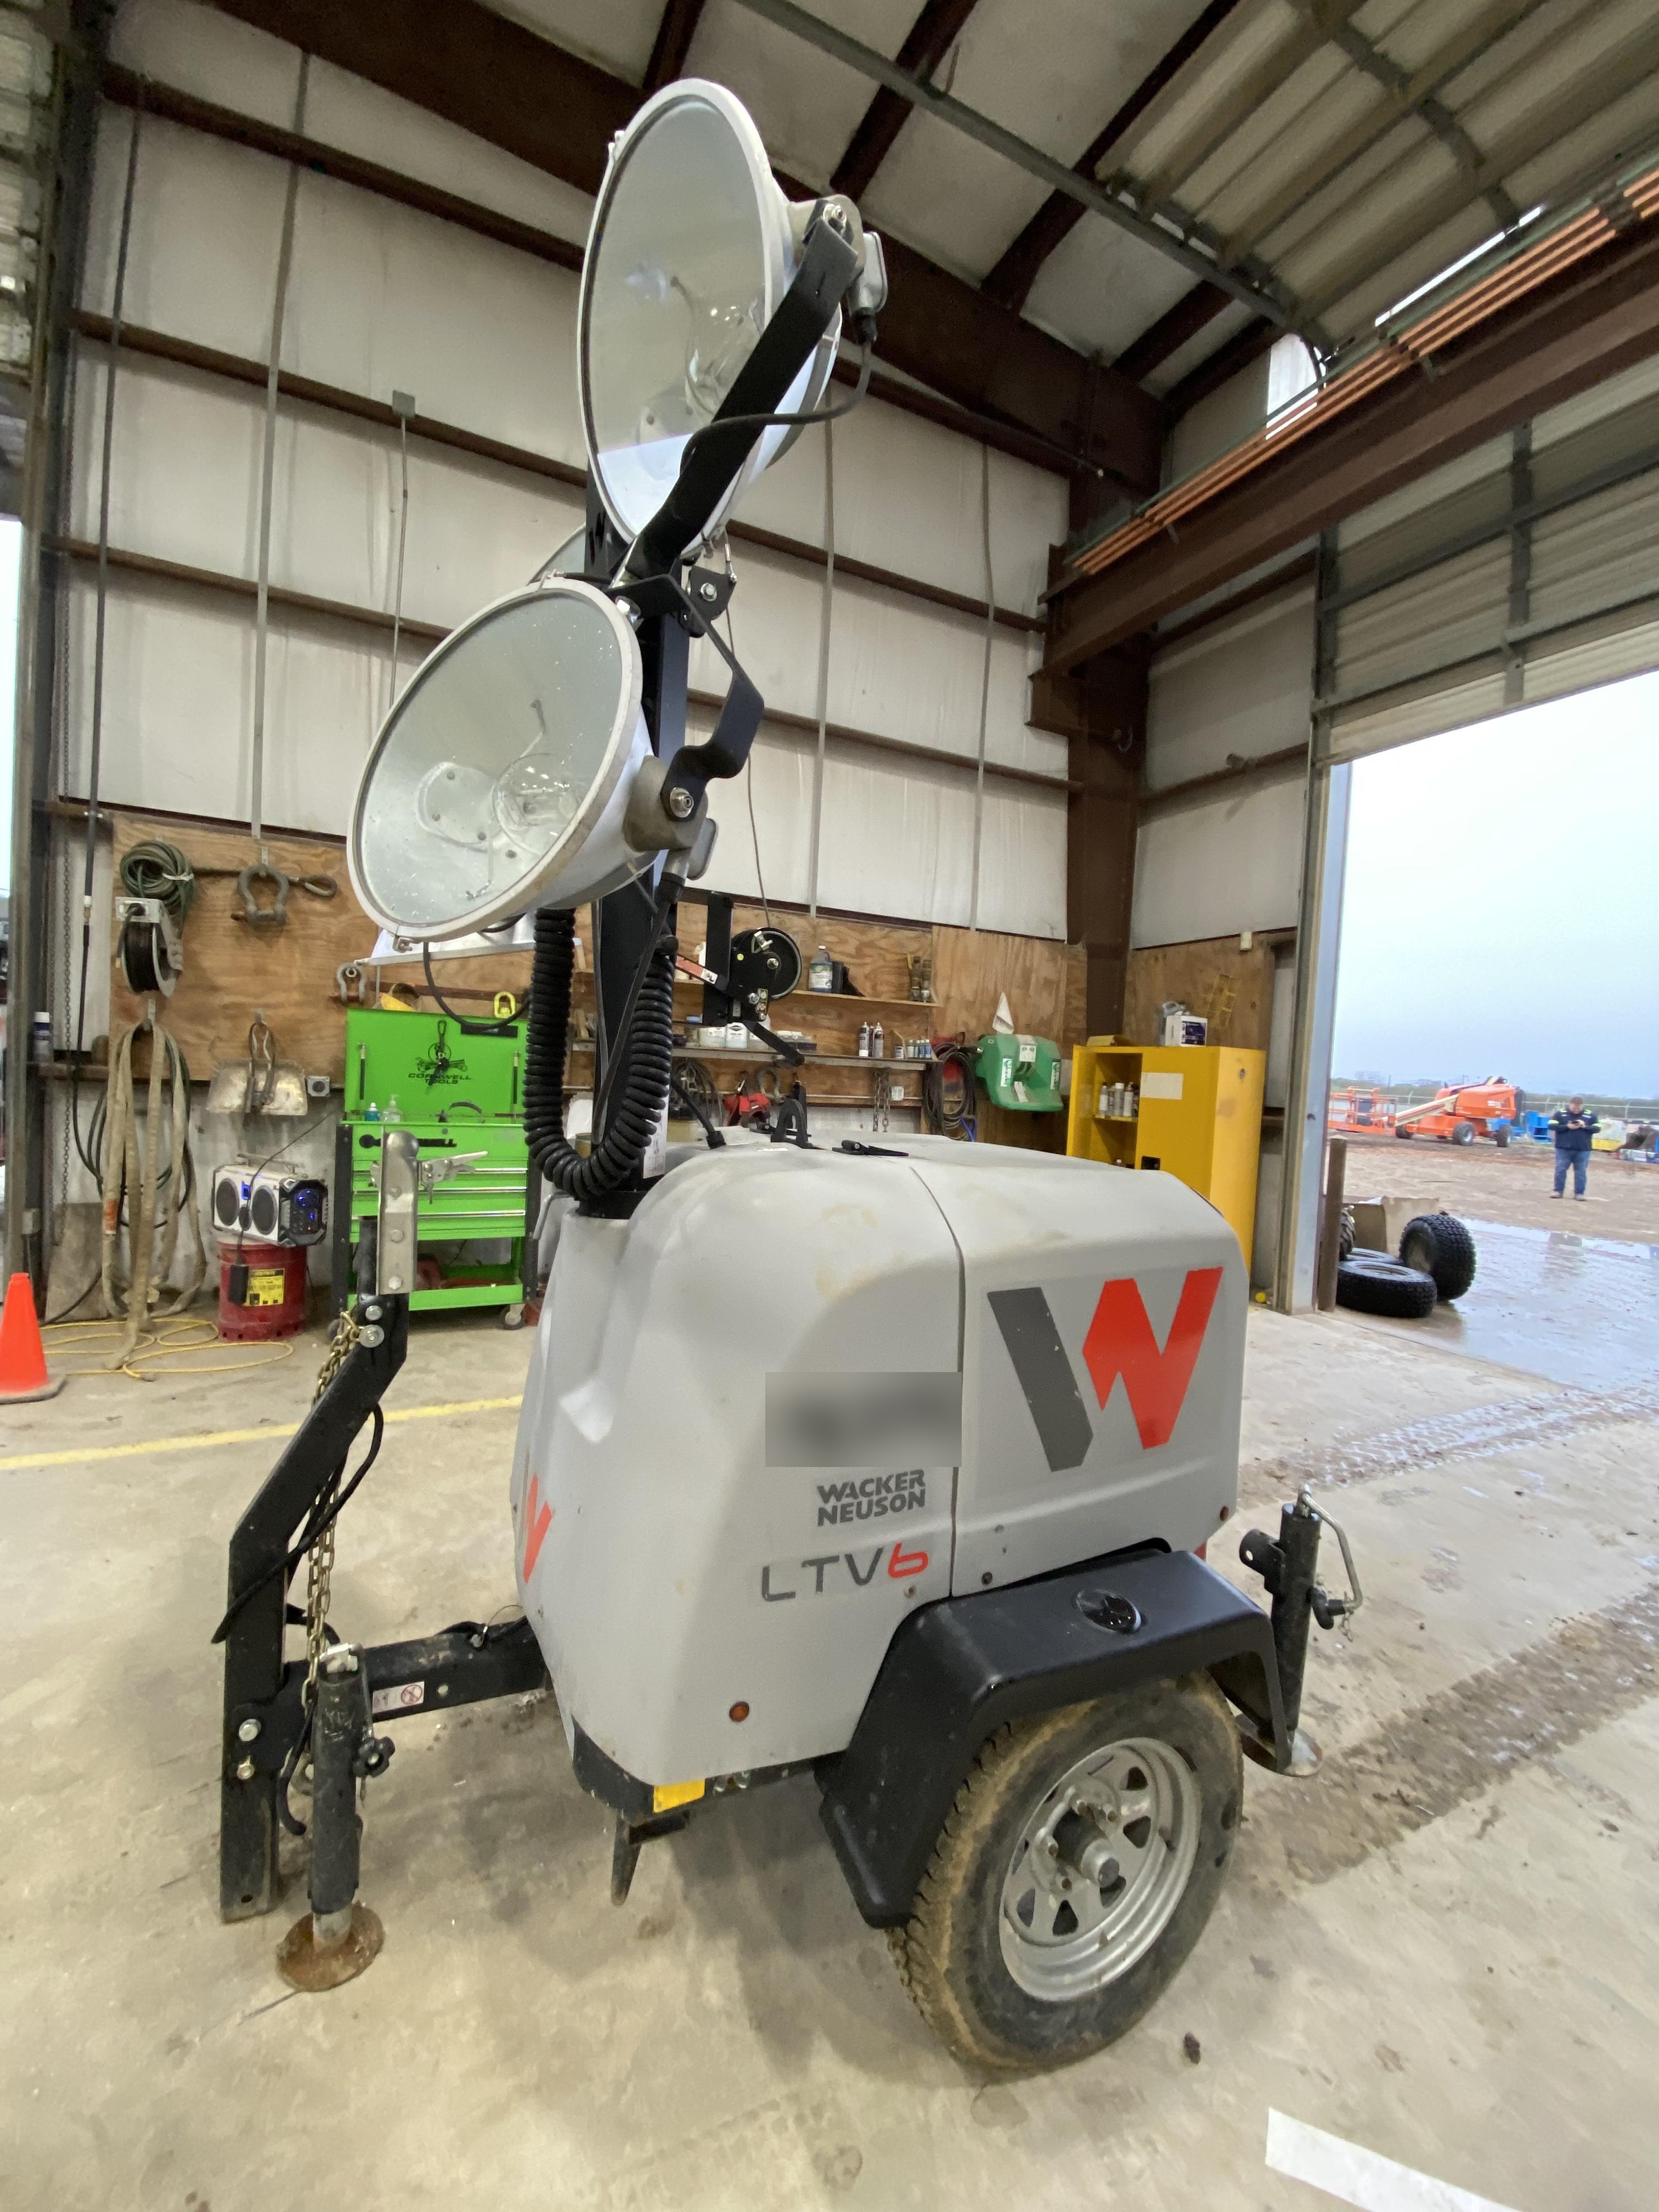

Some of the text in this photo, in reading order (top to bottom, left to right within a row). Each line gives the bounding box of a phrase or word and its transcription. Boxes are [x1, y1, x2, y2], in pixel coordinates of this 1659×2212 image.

[817, 1469, 926, 1504] WACKER
[817, 1488, 926, 1526] NEUSON
[761, 1542, 929, 1602] LTV6
